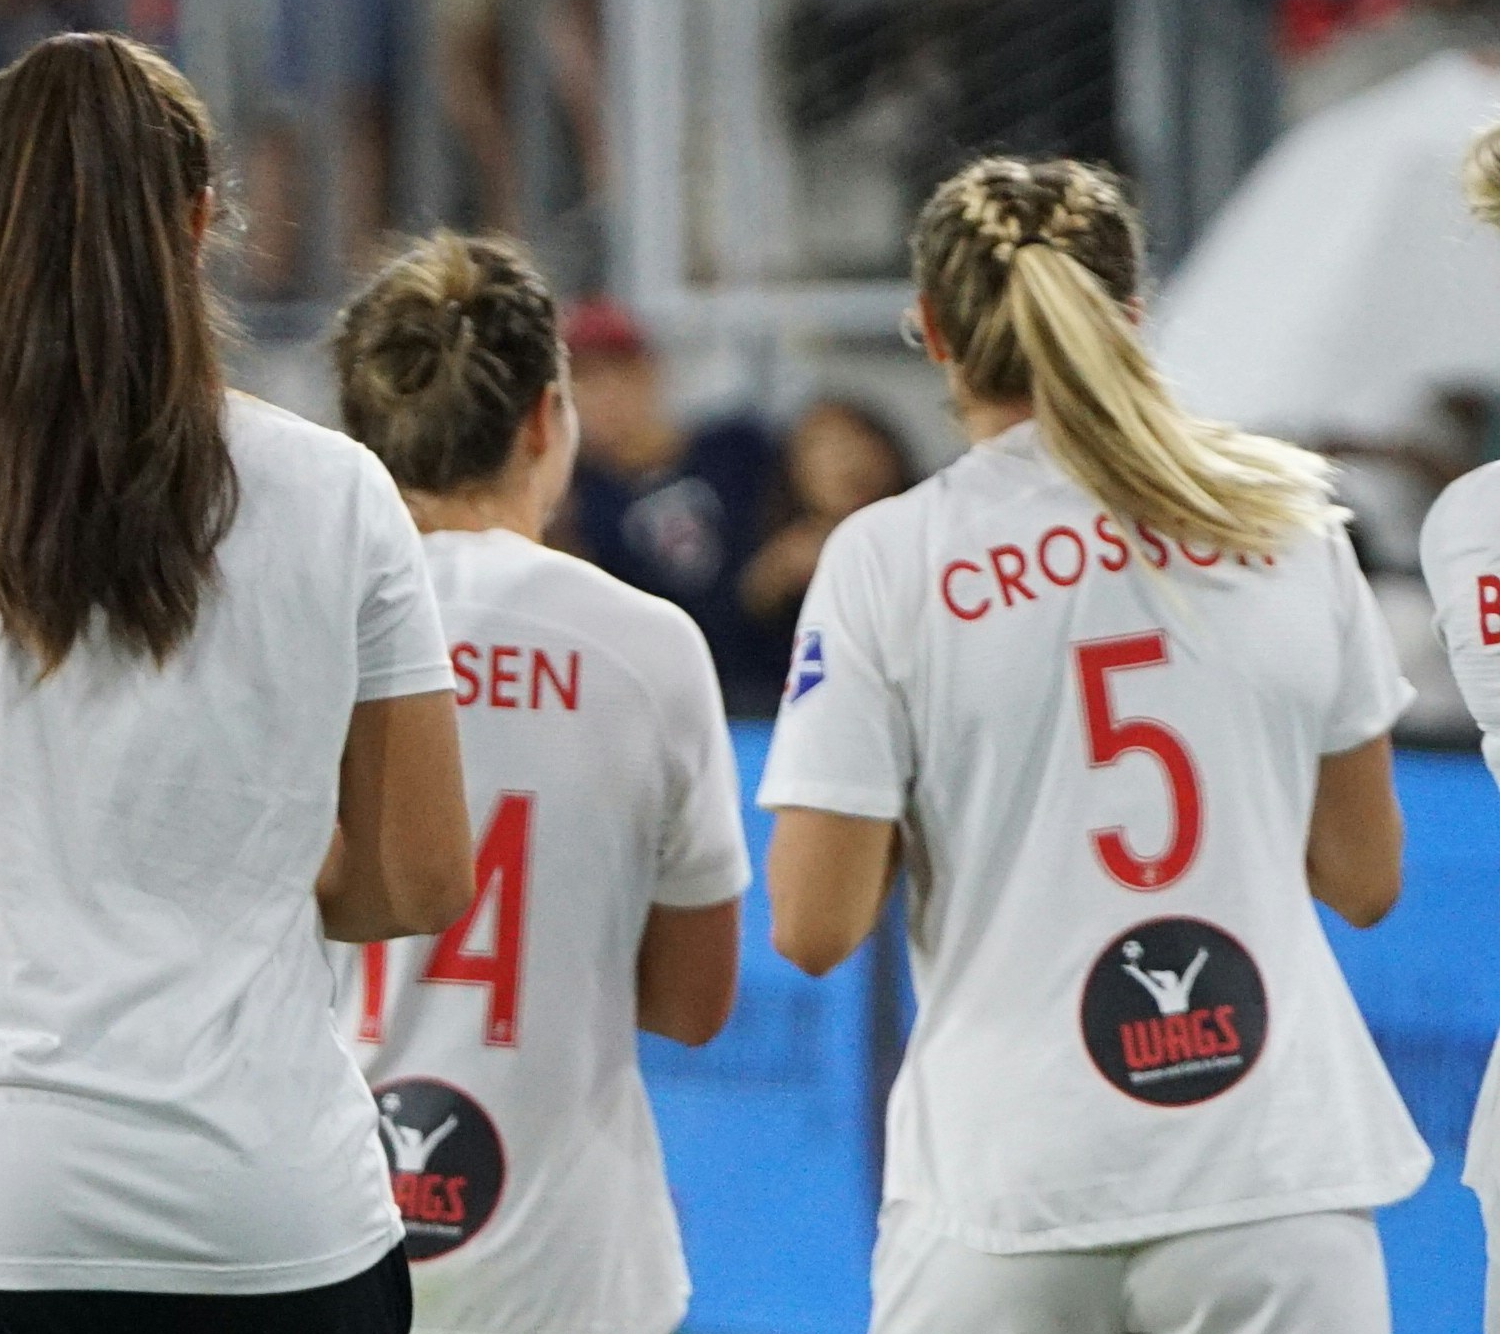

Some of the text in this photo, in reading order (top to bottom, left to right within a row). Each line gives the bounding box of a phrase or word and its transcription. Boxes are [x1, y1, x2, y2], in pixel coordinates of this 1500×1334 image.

[941, 512, 1275, 621] CROSS
[450, 641, 579, 710] SEN
[1073, 630, 1206, 893] 5
[1120, 1004, 1240, 1069] WAGS
[392, 1173, 467, 1222] AGS
